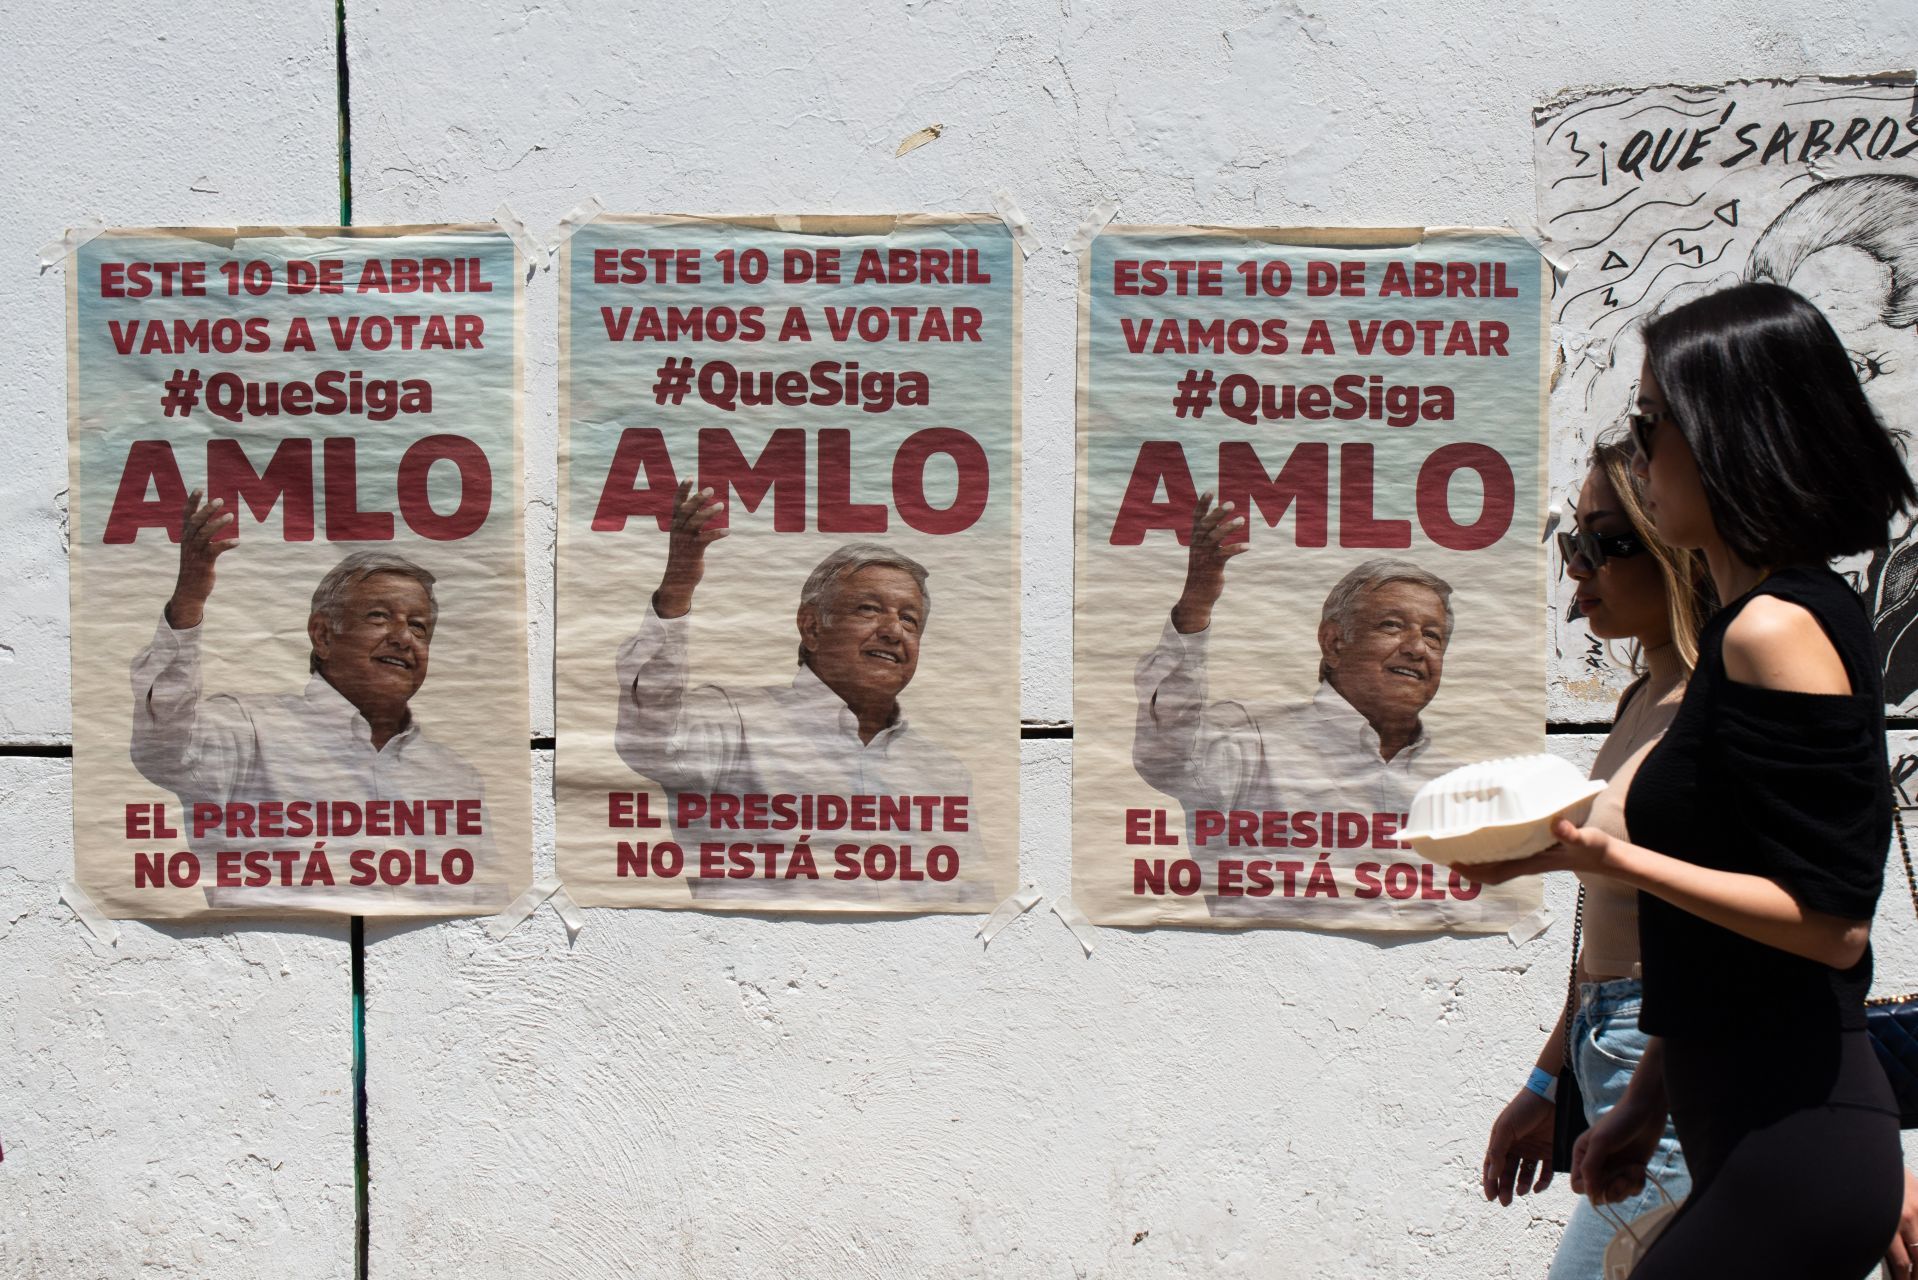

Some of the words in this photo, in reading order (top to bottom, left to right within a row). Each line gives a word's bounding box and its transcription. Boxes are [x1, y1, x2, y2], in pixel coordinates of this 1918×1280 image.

[101, 262, 205, 297] ESTE
[220, 261, 273, 296] 10
[287, 259, 343, 295] DE
[357, 258, 492, 294] ABRIL
[594, 249, 700, 284] ESTE
[715, 249, 768, 284] 10
[784, 249, 841, 284] DE
[854, 249, 990, 284] ABRIL
[1114, 261, 1222, 296] ESTE
[1237, 261, 1291, 297] 10
[1307, 262, 1365, 297] DE
[1379, 262, 1517, 297] ABRIL
[108, 318, 270, 355] VAMOS
[283, 317, 316, 352] A
[328, 315, 484, 351] VOTAR
[601, 306, 765, 342] VAMOS
[778, 307, 811, 341] A
[825, 307, 982, 342] VOTAR
[1121, 319, 1288, 354] VAMOS
[1301, 320, 1334, 355] A
[1349, 320, 1509, 356] VOTAR
[161, 368, 432, 421] #QueSiga
[653, 357, 929, 413] #QueSiga
[1173, 370, 1454, 427] #QueSiga
[102, 434, 492, 544] AMLO
[591, 427, 989, 535] AMLO
[1109, 441, 1515, 550] AMLO
[126, 803, 178, 839] EL
[193, 799, 482, 838] PRESIDENTE
[608, 792, 661, 828] EL
[677, 793, 968, 832] PRESIDENTE
[1125, 809, 1178, 845] EL
[1195, 811, 1412, 850] PRESIDE
[134, 851, 200, 888] NO
[216, 842, 335, 887] ESTÁ
[349, 848, 474, 886] SOLO
[616, 841, 684, 878] NO
[700, 835, 819, 879] ESTÁ
[833, 843, 960, 882] SOLO
[1133, 858, 1201, 896] NO
[1217, 853, 1339, 898] ESTÁ
[1354, 862, 1482, 901] SOLO
